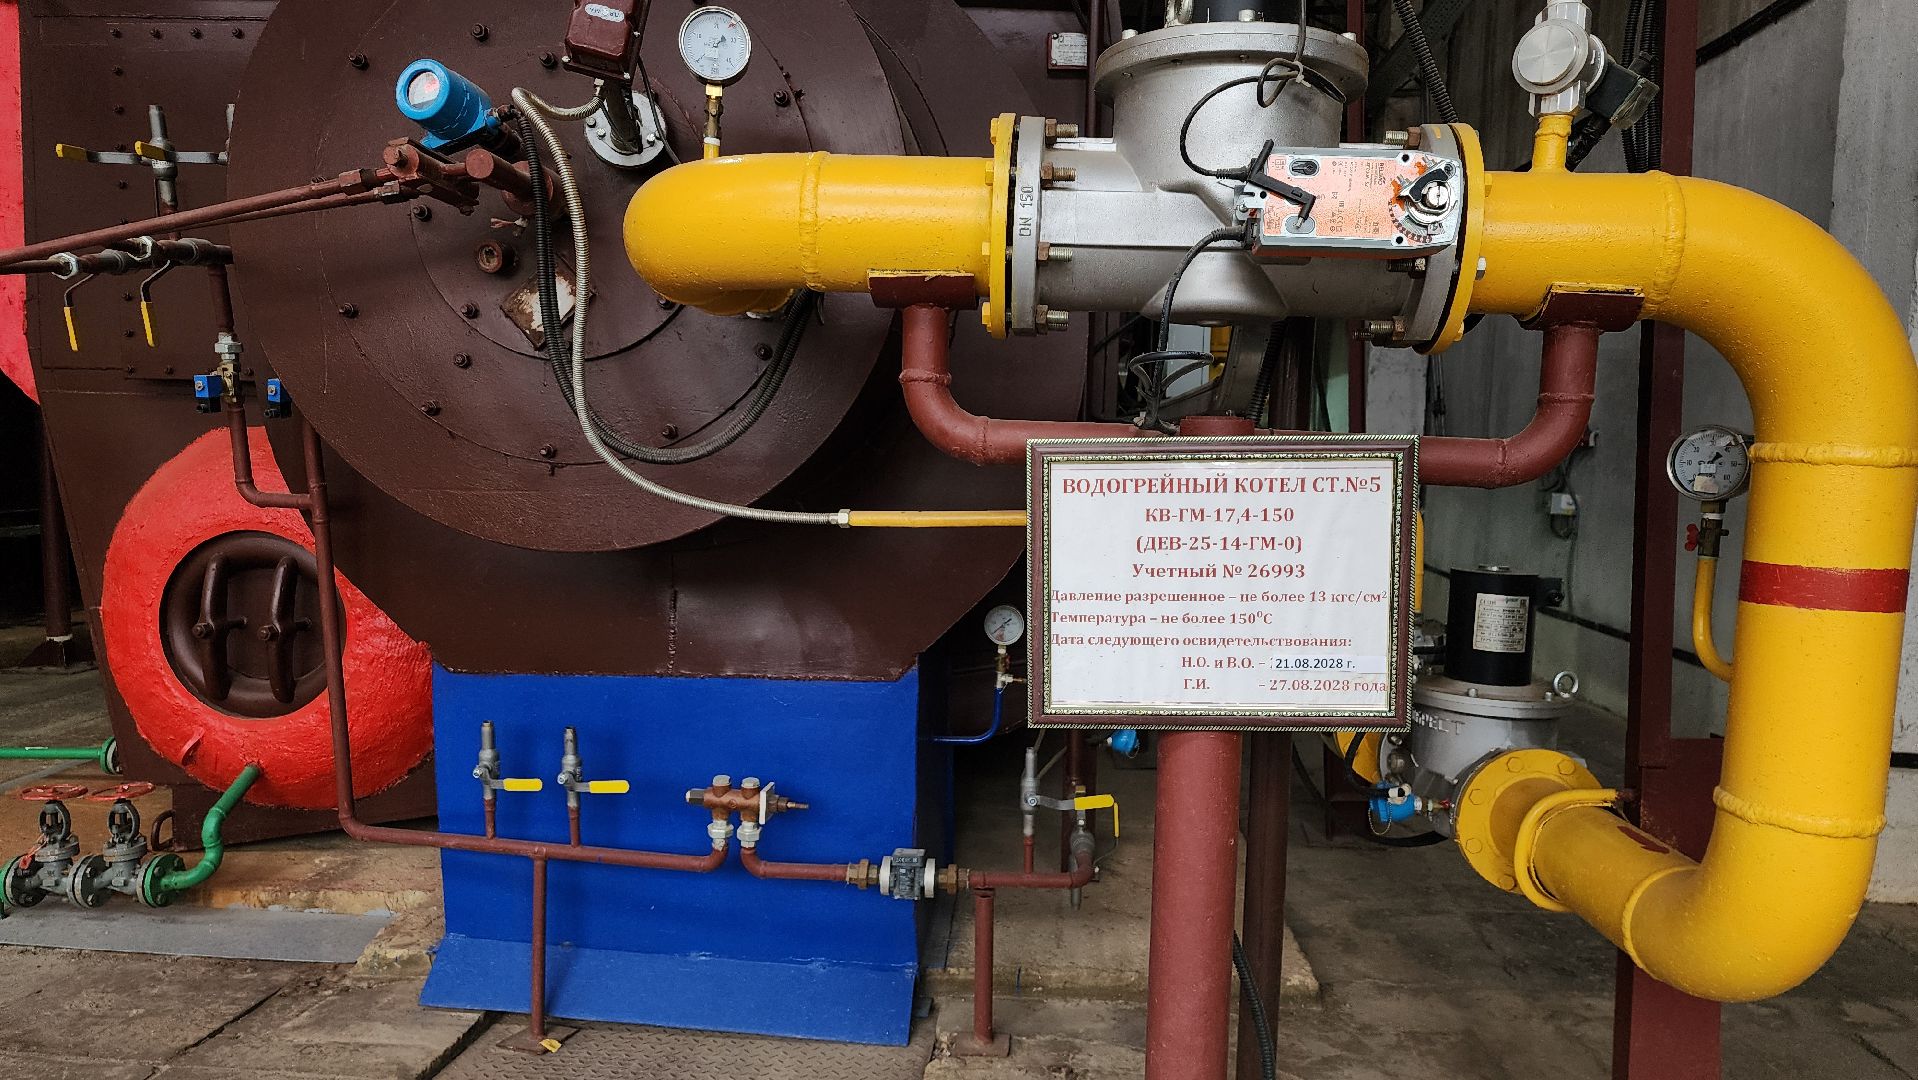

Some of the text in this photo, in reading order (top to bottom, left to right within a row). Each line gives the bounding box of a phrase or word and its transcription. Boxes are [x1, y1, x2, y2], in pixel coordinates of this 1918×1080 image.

[1018, 186, 1034, 237] DN 150
[1062, 472, 1382, 498] ВОДОГРЕЙНЫЙ КОТЕЛ СТ.№5
[1144, 507, 1295, 525] КВ-ГМ-17,4-150
[1135, 535, 1303, 554] (ДЕВ-25-14-ГМ-0)
[1132, 563, 1306, 579] Учетный № 26993
[1051, 589, 1122, 603] Давление
[1125, 591, 1226, 605] разрешенное
[1239, 592, 1258, 603] не
[1261, 590, 1306, 603] более
[1309, 590, 1327, 602] 13
[1051, 611, 1147, 627] Температура
[1160, 614, 1179, 625] не
[1182, 612, 1226, 625] более
[1051, 633, 1352, 649] Дата следующего освидетельствования:
[1181, 656, 1211, 669] Н.О.
[1213, 658, 1224, 669] и
[1226, 656, 1256, 669] В.О.
[1275, 658, 1344, 669] 21.08.2028
[1346, 660, 1356, 669] г.
[1183, 677, 1211, 690] Г.И.
[1269, 678, 1350, 692] 27.08.2028
[1353, 682, 1388, 694] года
